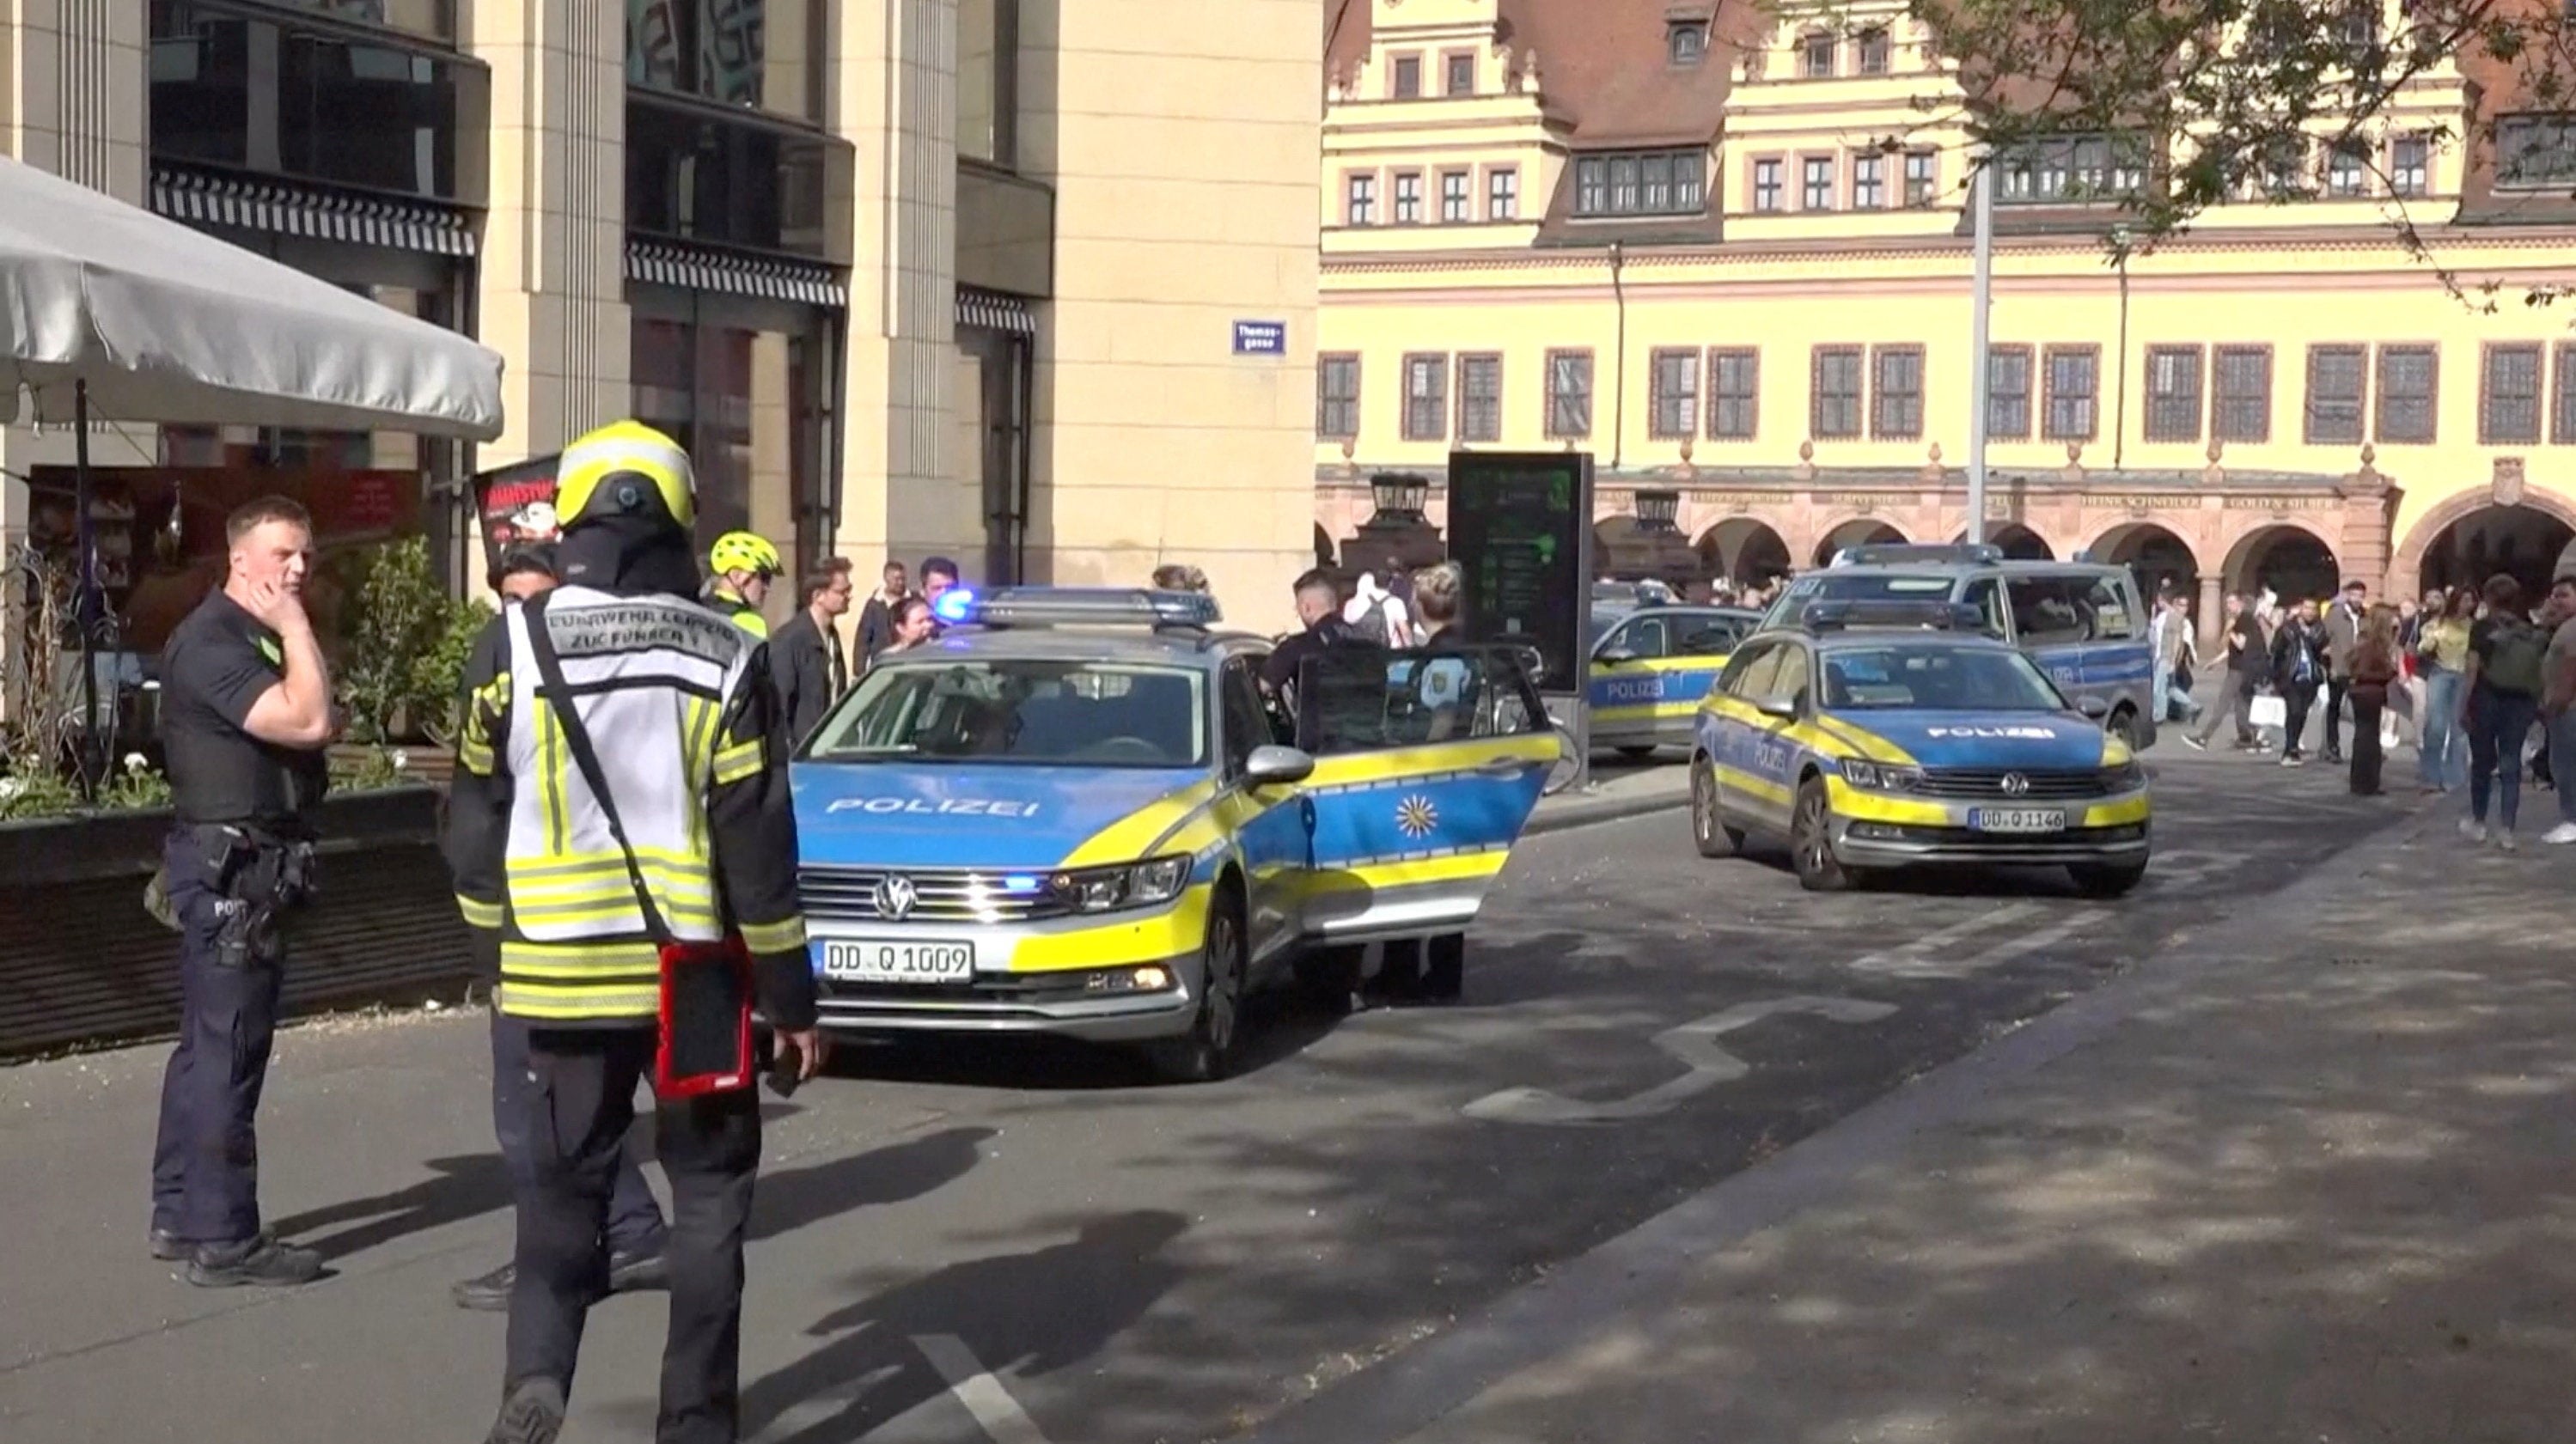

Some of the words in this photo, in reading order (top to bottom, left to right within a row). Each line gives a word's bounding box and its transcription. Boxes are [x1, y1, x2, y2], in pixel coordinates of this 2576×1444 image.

[1244, 338, 1274, 350] gasse
[2231, 497, 2270, 509] GOLD
[1608, 679, 1664, 700] POLIZEI
[1926, 728, 2057, 740] POLIZEI
[826, 797, 1040, 817] POLIZEI
[2011, 812, 2023, 826] Q
[2026, 813, 2063, 826] 1146
[828, 945, 860, 970] DD
[879, 946, 895, 970] Q
[903, 947, 968, 972] 1009
